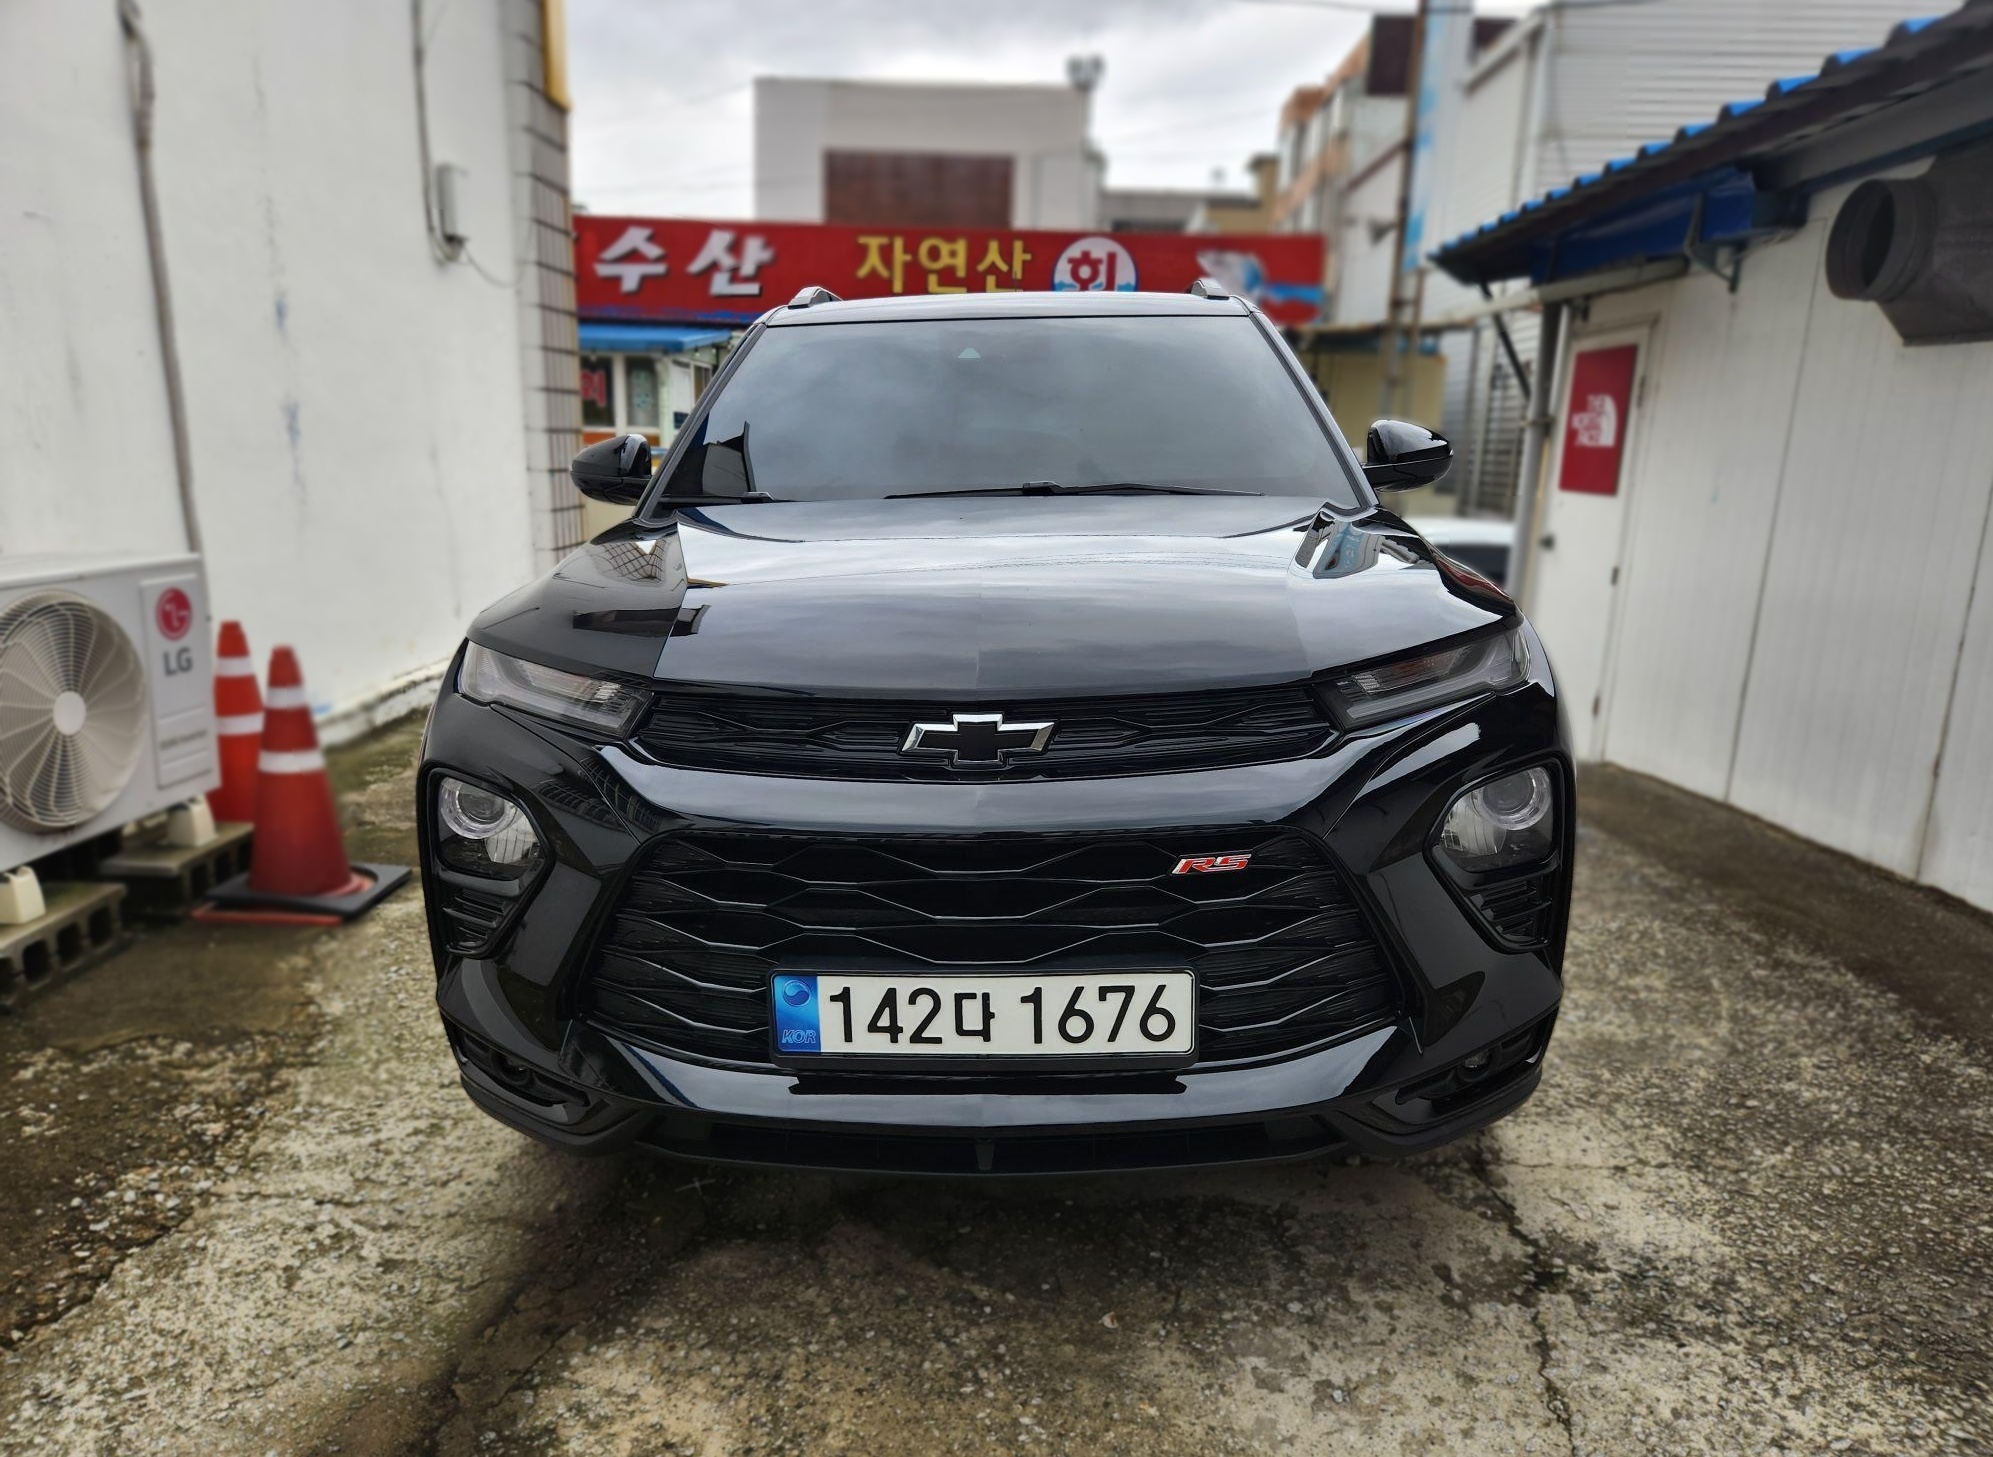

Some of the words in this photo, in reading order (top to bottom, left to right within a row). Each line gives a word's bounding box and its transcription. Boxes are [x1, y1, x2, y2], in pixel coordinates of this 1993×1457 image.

[856, 236, 1032, 294] 자연산
[1067, 250, 1117, 291] 회
[163, 647, 193, 677] LG
[1172, 854, 1252, 875] RS
[829, 986, 996, 1044] 142다
[1020, 985, 1177, 1045] 1676
[782, 1029, 817, 1044] KOR
